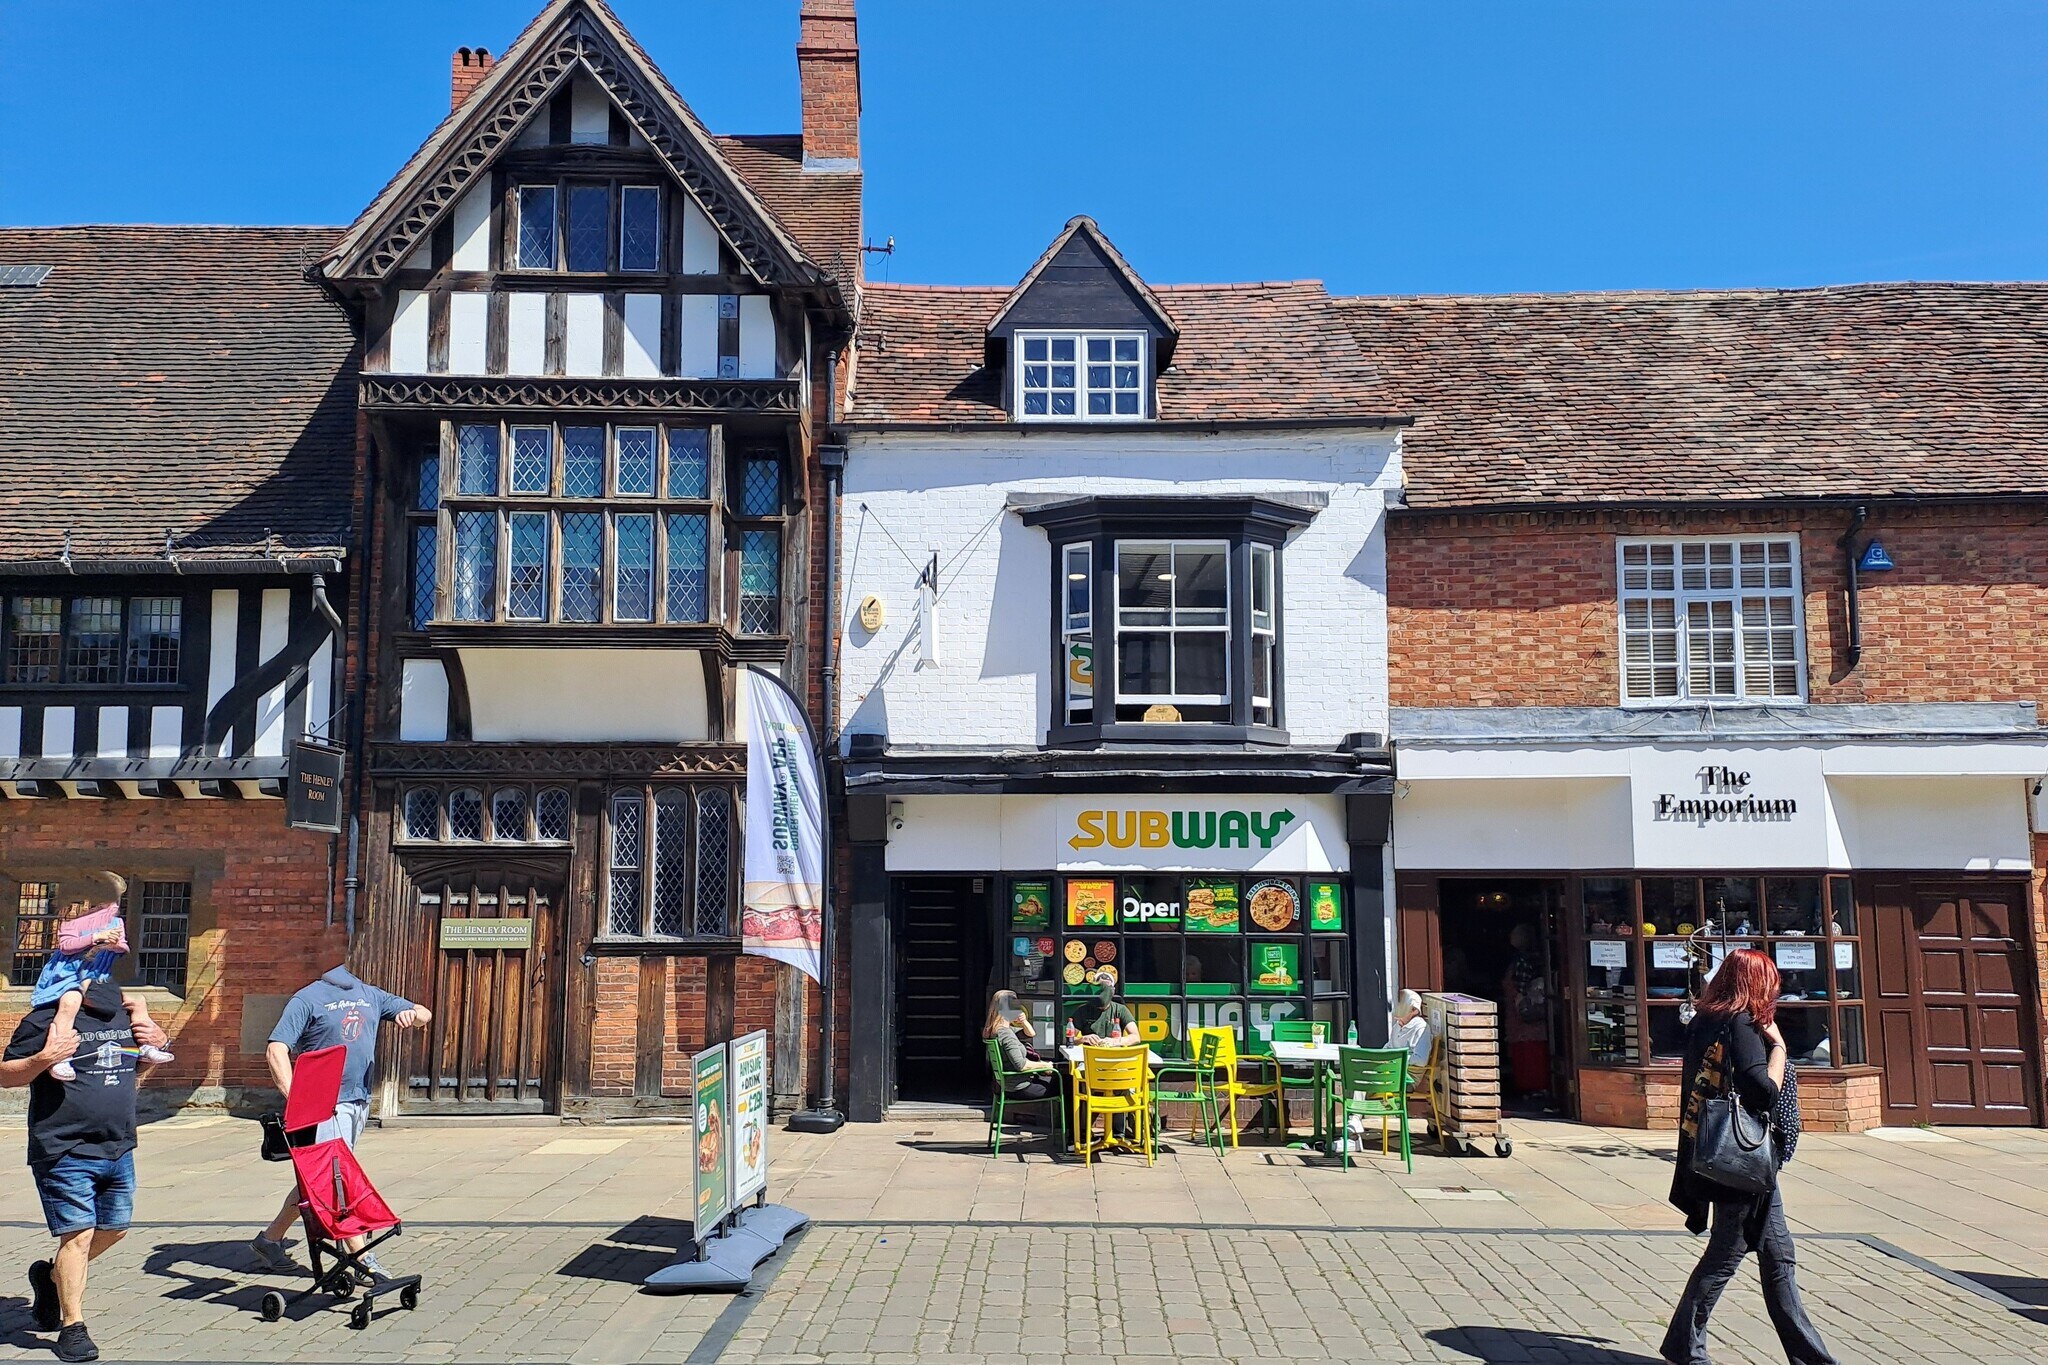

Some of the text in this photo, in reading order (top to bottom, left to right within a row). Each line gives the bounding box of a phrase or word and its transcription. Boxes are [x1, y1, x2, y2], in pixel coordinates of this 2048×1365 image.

[300, 771, 335, 788] THE HENLEY
[1700, 765, 1752, 787] The
[307, 789, 326, 802] ROOM
[1658, 793, 1798, 820] Emporium
[1067, 807, 1297, 852] SUBWAY
[1123, 897, 1180, 922] Open
[445, 925, 527, 934] THE HENLEY ROOM
[95, 1029, 118, 1041] GUYS
